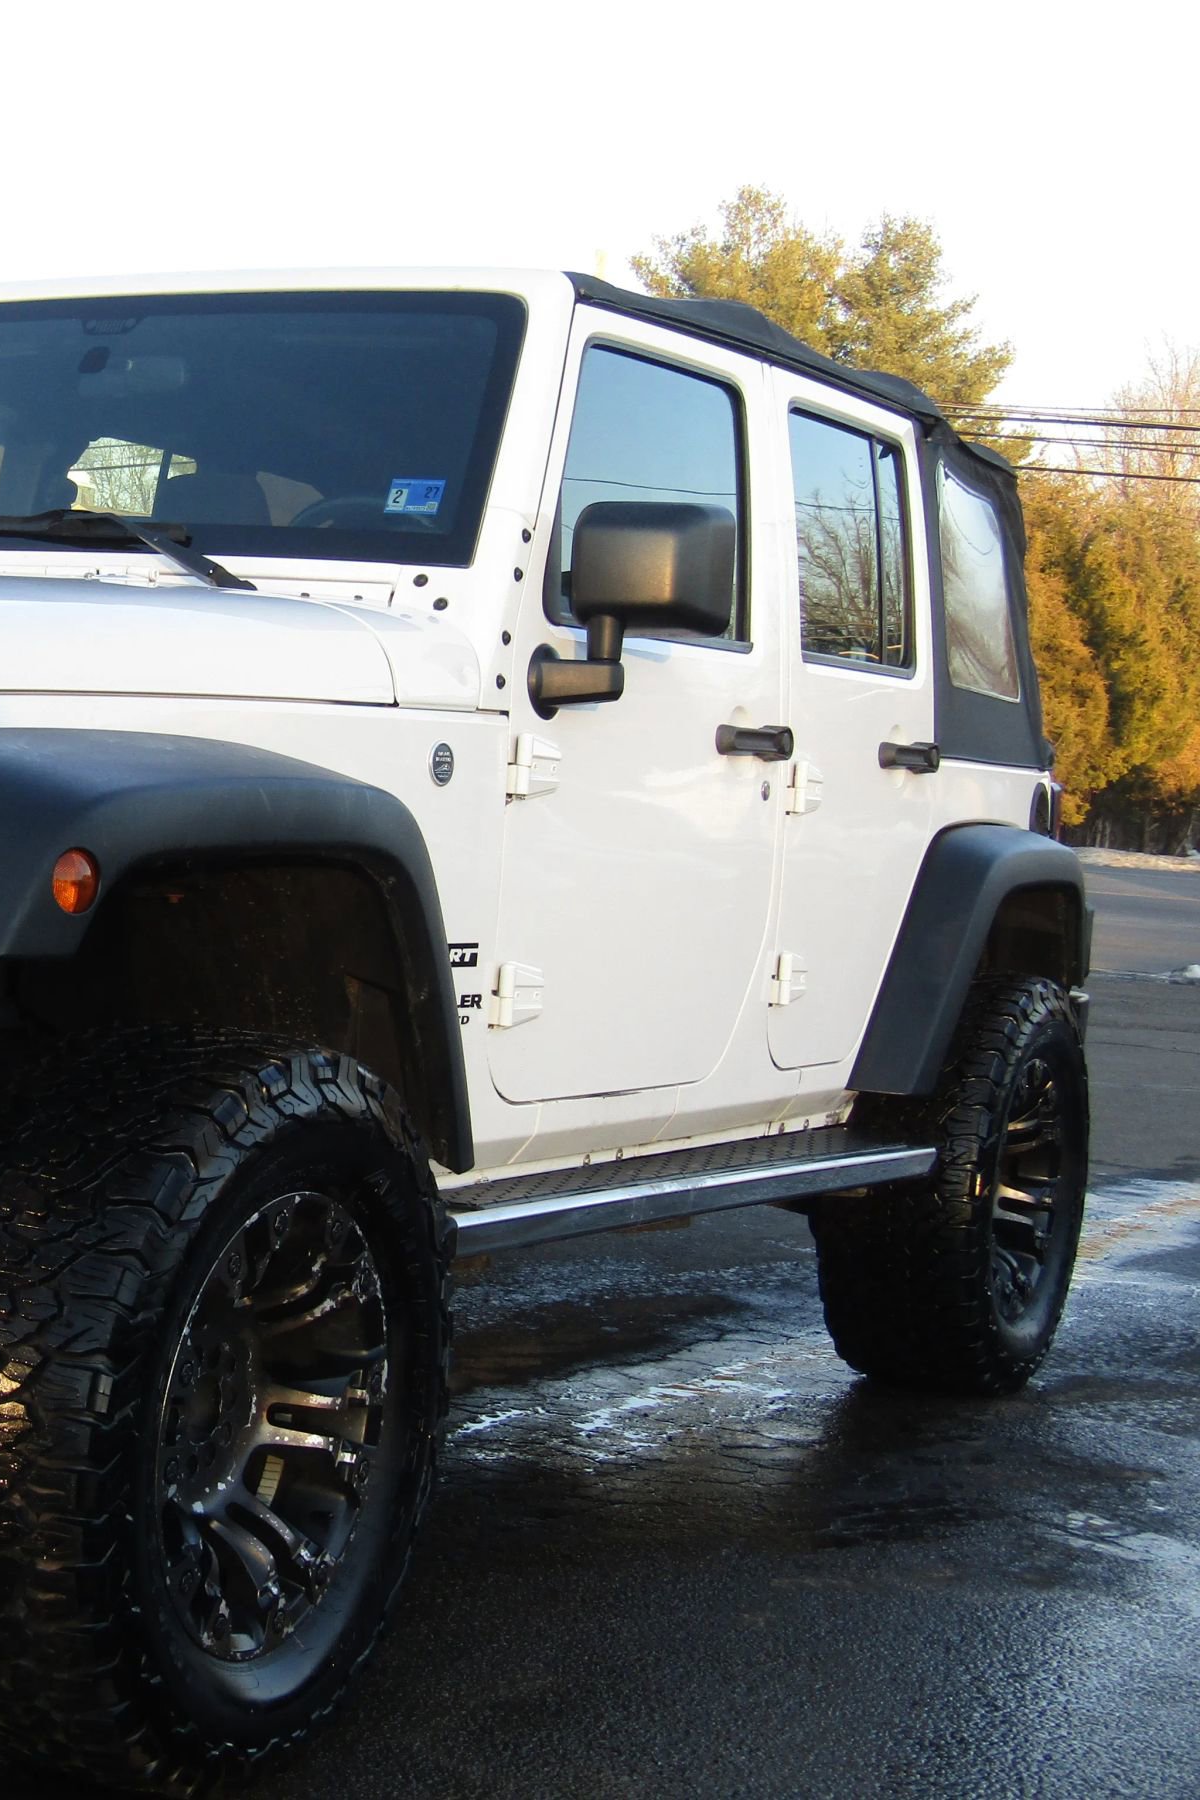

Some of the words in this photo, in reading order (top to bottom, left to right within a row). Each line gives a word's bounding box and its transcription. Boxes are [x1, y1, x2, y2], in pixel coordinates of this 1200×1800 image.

[392, 489, 404, 504] 2
[424, 486, 441, 499] 27
[457, 993, 483, 1010] ER
[459, 1014, 470, 1025] D
